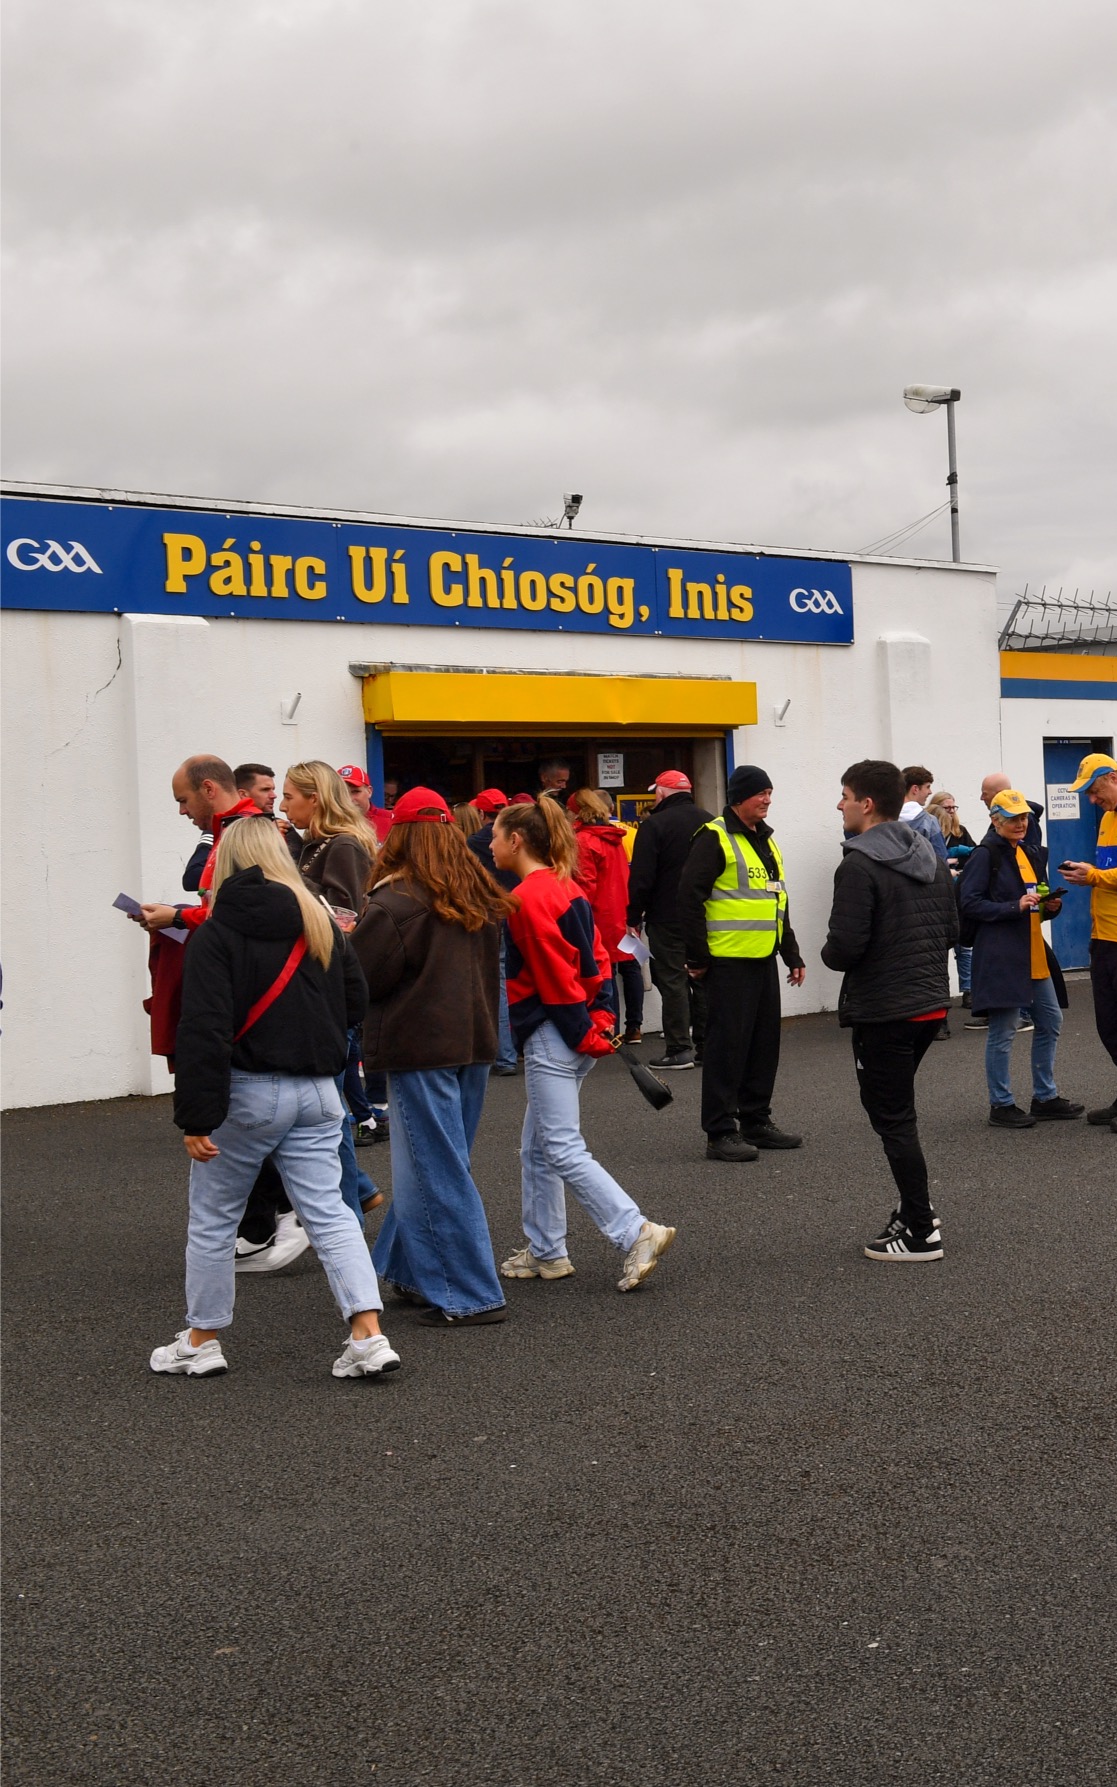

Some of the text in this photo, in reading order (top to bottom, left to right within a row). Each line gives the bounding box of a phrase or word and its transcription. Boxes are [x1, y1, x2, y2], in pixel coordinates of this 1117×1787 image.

[6, 537, 103, 574] GAA
[162, 532, 754, 629] Páirc Uí Chíosóg, Inis
[788, 587, 844, 616] GAA
[747, 867, 767, 879] 533
